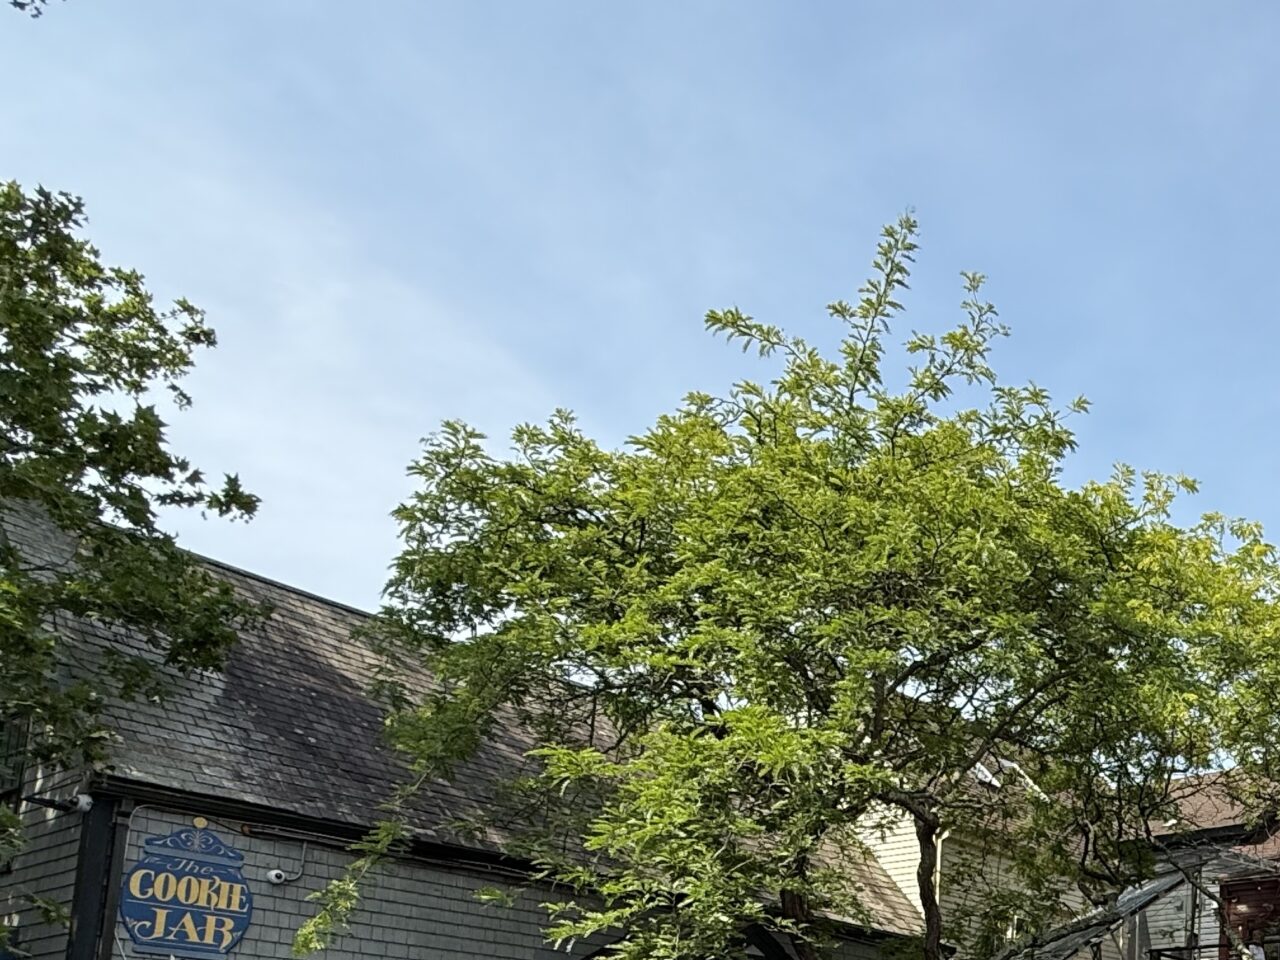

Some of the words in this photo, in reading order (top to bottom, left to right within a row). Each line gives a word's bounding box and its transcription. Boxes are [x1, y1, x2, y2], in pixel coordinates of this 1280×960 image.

[167, 858, 214, 875] The
[129, 868, 249, 913] COOKIE
[134, 907, 235, 953] JAR
